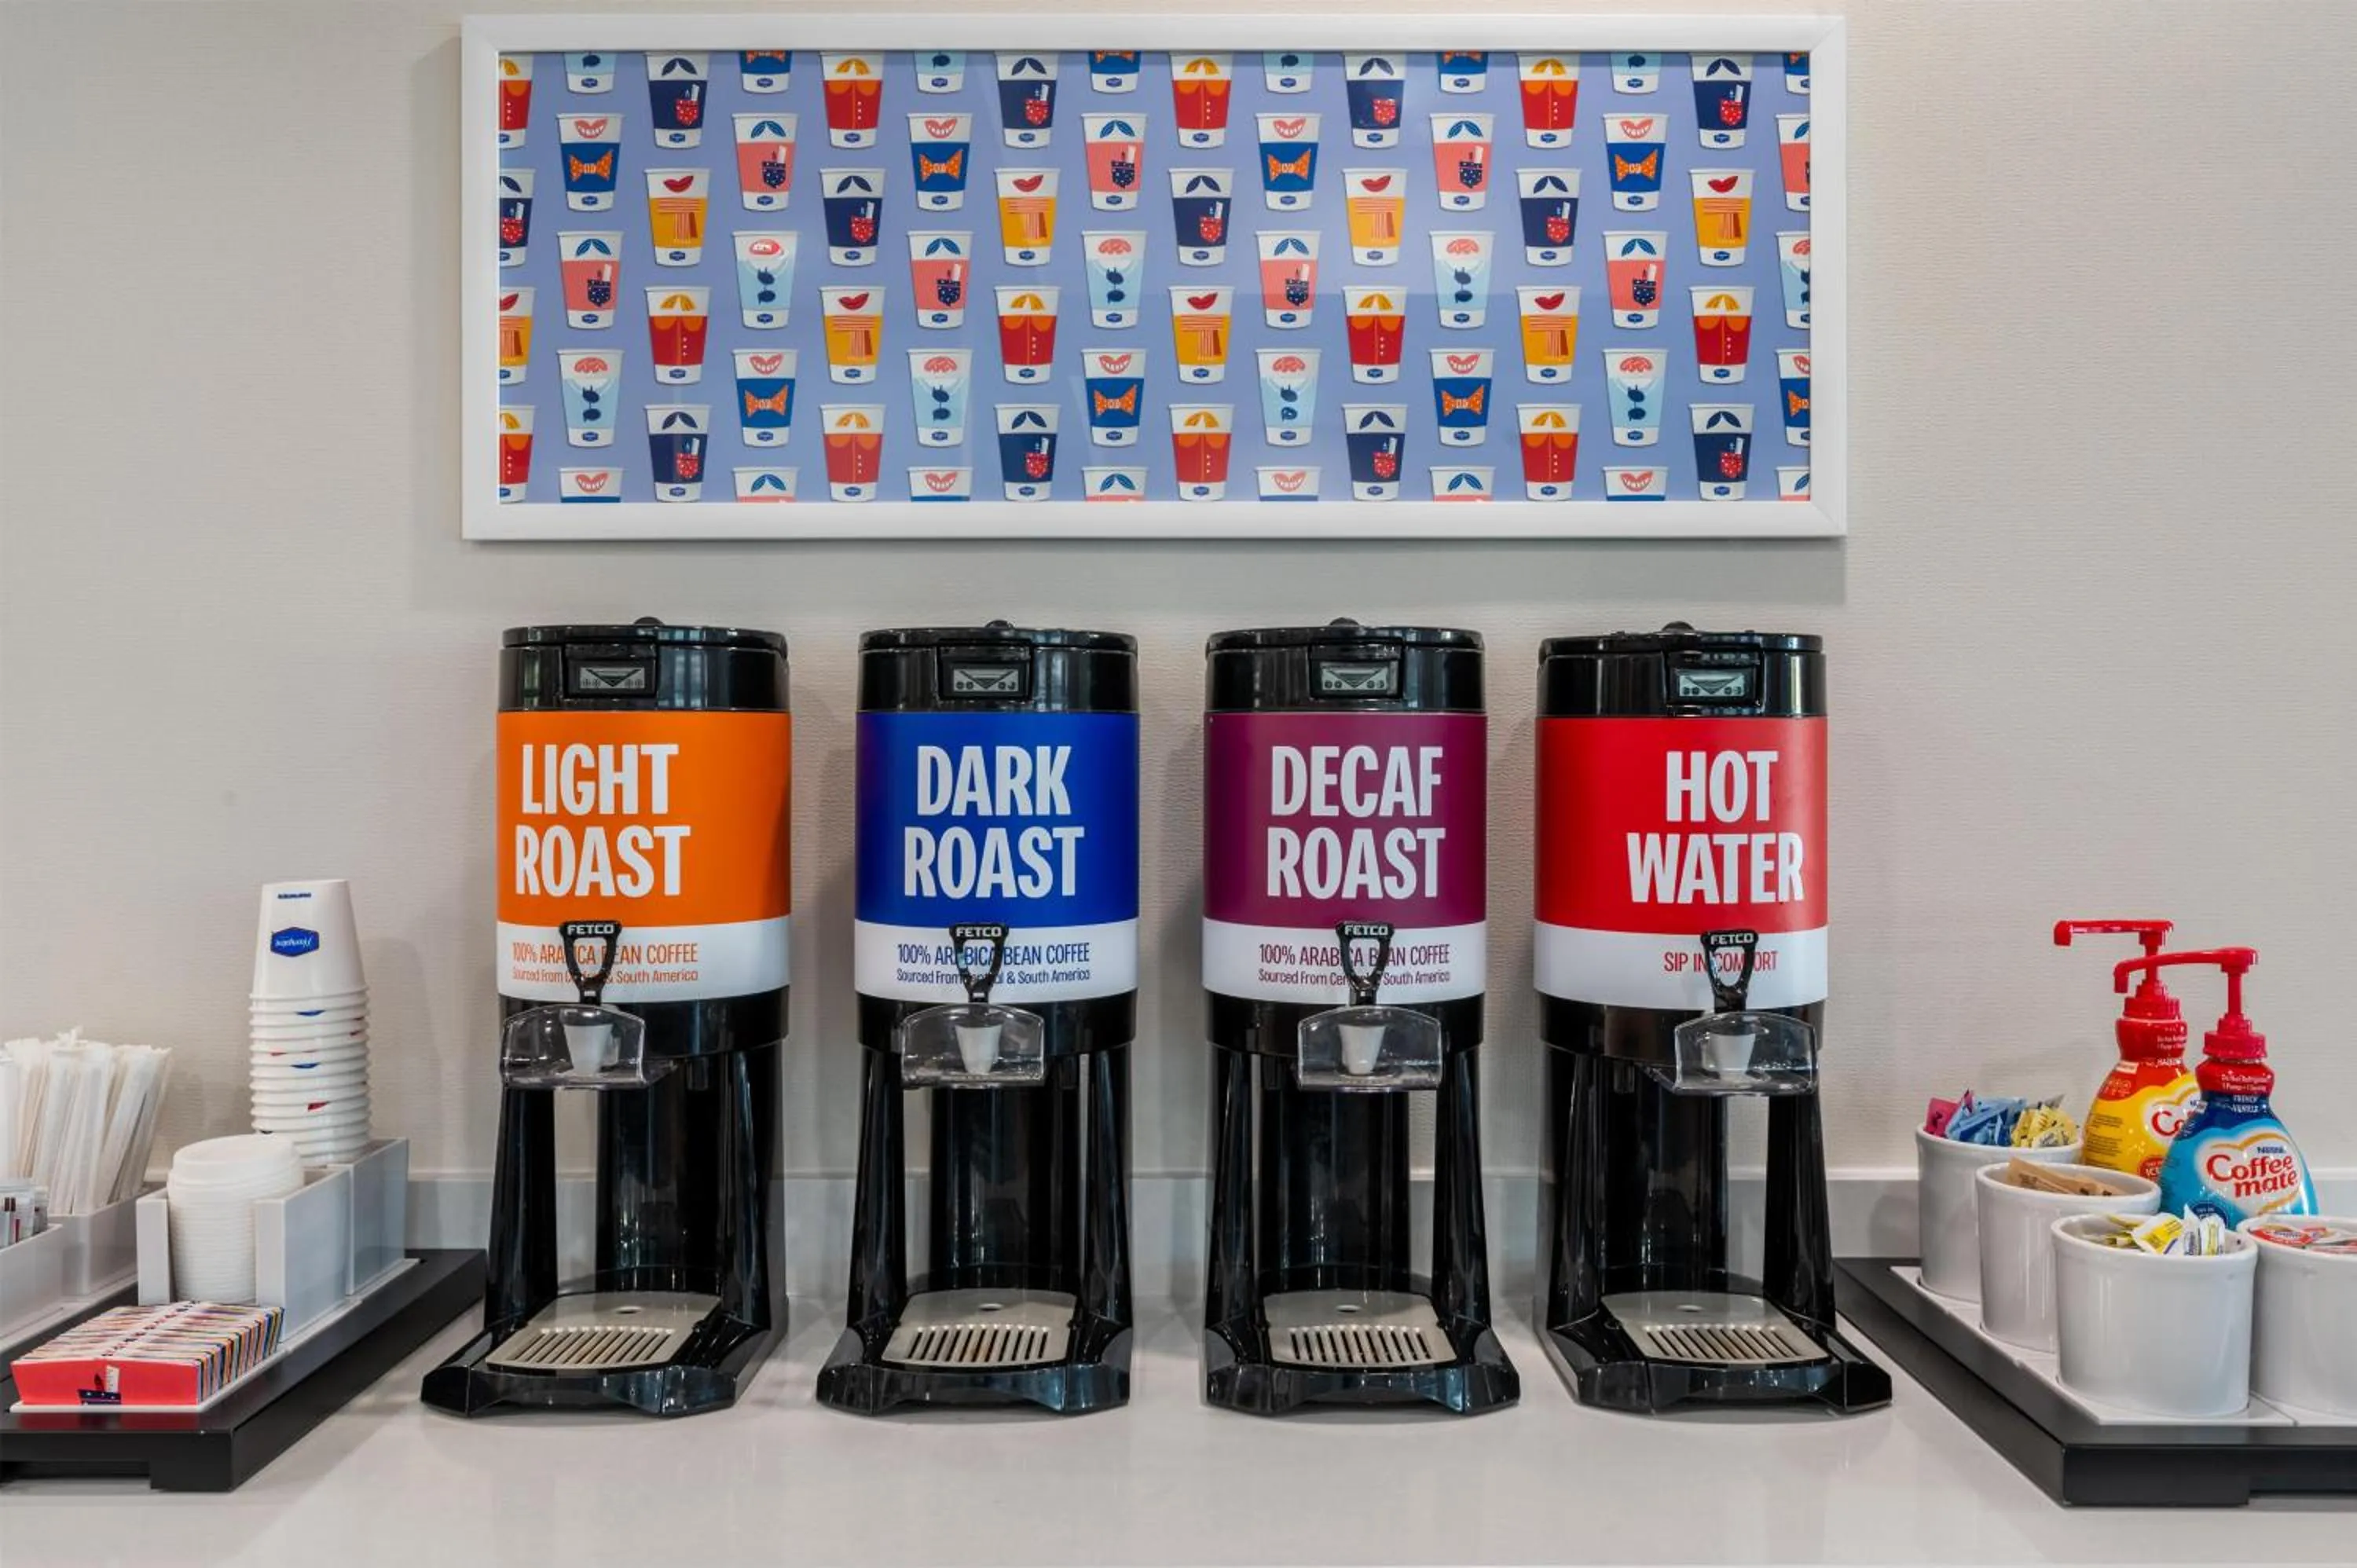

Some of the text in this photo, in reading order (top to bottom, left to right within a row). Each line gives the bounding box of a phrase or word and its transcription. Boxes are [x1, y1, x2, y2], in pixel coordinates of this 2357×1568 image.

[522, 743, 679, 816] LIGHT
[916, 745, 1072, 817] DARK
[1270, 745, 1443, 818] DECAF
[1665, 749, 1779, 822] HOT
[515, 824, 691, 898] ROAST
[904, 826, 1085, 899] ROAST
[1266, 826, 1446, 900] ROAST
[1626, 831, 1805, 905] WATER
[566, 924, 614, 936] FETCO
[955, 926, 1002, 937] FETCO
[1343, 924, 1388, 936] FETCO
[1710, 932, 1754, 945] FETCO
[512, 943, 537, 963] 100%
[539, 943, 596, 965] ARACA
[646, 943, 698, 965] COFFEE
[896, 943, 1090, 966] 100% ARBIC BEAN COFFEE
[1259, 943, 1450, 967] 100% ARABA BAN COFFEE
[1663, 950, 1779, 973] SIP IN COMORT
[617, 969, 651, 984] South
[653, 969, 698, 983] America
[896, 967, 935, 984] Sourced
[1006, 971, 1015, 984] &
[1017, 969, 1049, 984] South
[1050, 967, 1091, 983] America
[1258, 967, 1299, 984] Sourced
[1300, 970, 1327, 985] From
[1383, 971, 1413, 986] South
[1415, 969, 1451, 985] America
[2206, 1154, 2293, 1182] Coffee
[2234, 1170, 2298, 1198] mate
